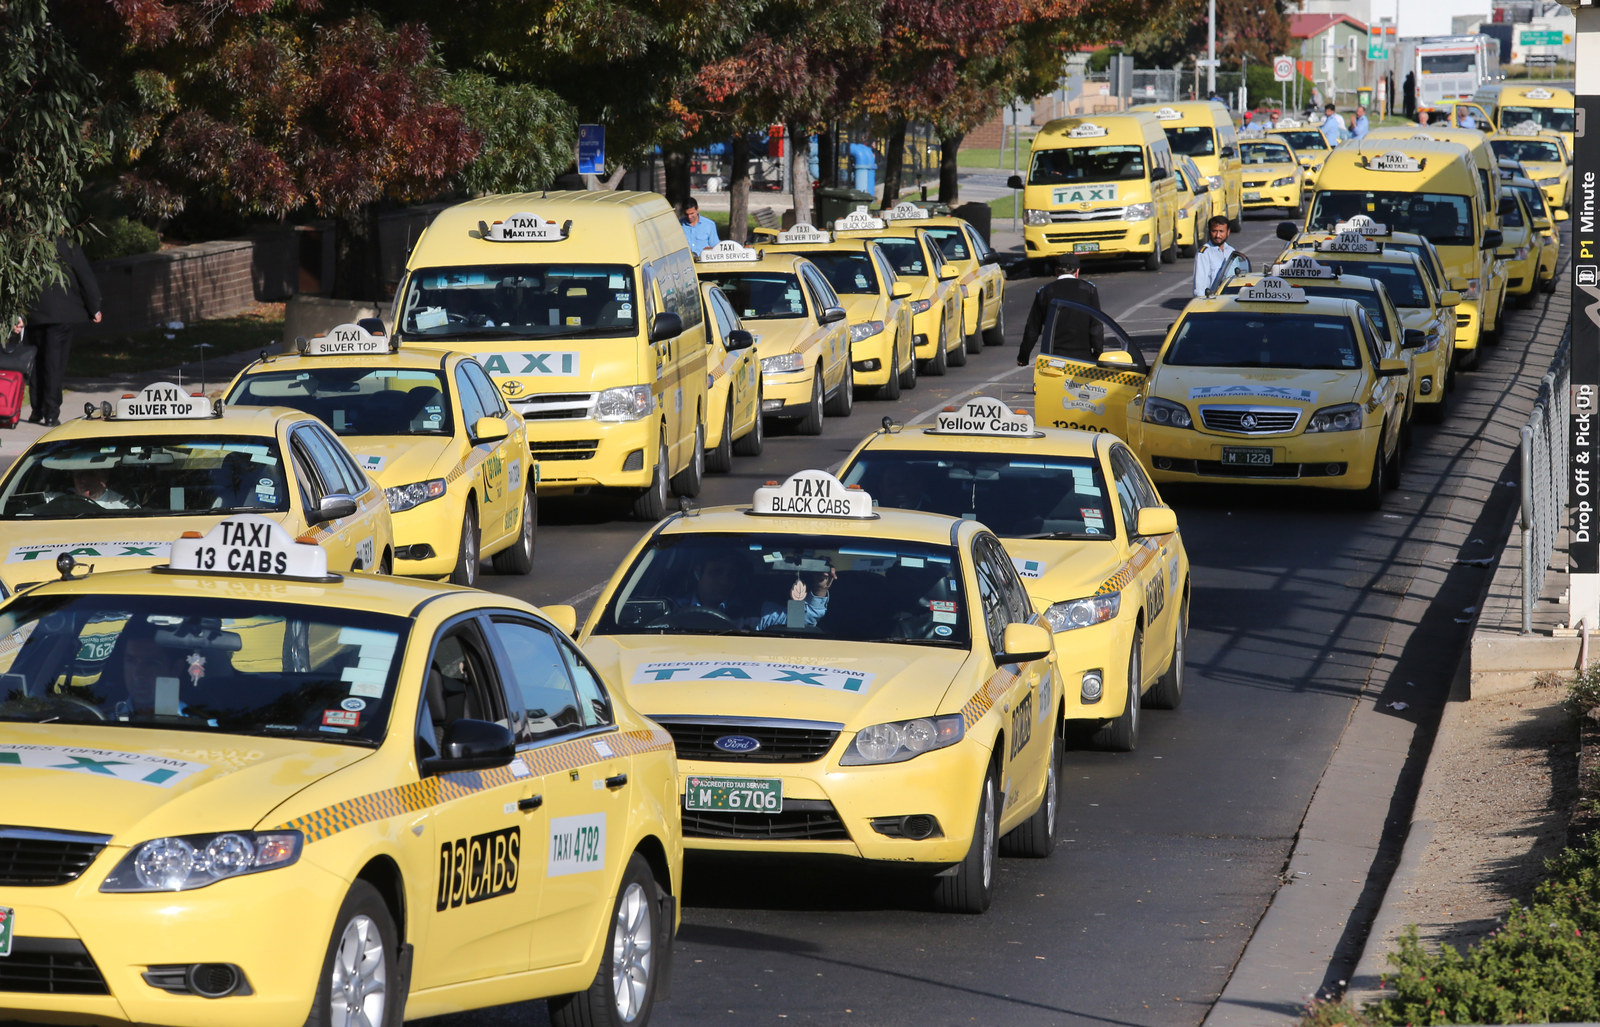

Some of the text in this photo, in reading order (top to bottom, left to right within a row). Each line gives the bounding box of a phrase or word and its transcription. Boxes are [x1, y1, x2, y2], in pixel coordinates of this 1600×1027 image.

[1278, 65, 1290, 73] 40
[1386, 154, 1402, 163] TAXI
[1054, 190, 1114, 203] TAXI
[1580, 172, 1595, 232] Minute
[512, 218, 538, 228] TAXI
[843, 222, 860, 230] BLACK
[1352, 218, 1370, 227] TAXI
[503, 228, 546, 239] MAXI TAXI
[1340, 234, 1360, 244] TAXI
[1330, 243, 1350, 251] BLACK
[1580, 240, 1594, 258] P1
[726, 252, 750, 260] SERVICE
[1292, 258, 1312, 268] TAXI
[1280, 268, 1305, 276] SILVER
[1264, 280, 1282, 288] TAXI
[335, 331, 360, 342] TAXI
[320, 342, 378, 352] SILVER TOP
[472, 353, 572, 374] AXI
[144, 389, 178, 402] TAXI
[1193, 386, 1312, 398] TAXI
[128, 403, 192, 416] SILVER TOP
[967, 404, 1002, 418] TAXI
[938, 418, 1028, 432] Yellow Cabs
[1228, 453, 1271, 464] M 1228
[1575, 384, 1594, 542] Drop Off & Pick Up
[793, 478, 830, 498] TAXI
[772, 497, 850, 515] BLACK CABS
[220, 521, 272, 548] TAXI
[15, 546, 160, 560] TAX
[195, 547, 288, 574] 13 CABS
[832, 668, 865, 678] 5AM
[644, 668, 864, 692] TAXI
[724, 738, 750, 750] Ford
[62, 746, 113, 756] 10PM
[116, 752, 140, 760] TO
[144, 756, 188, 768] 5AM
[0, 752, 180, 785] XI
[746, 782, 770, 790] SERVICE
[688, 788, 696, 806] VIC
[700, 788, 776, 808] M 6706
[553, 826, 600, 863] TAXI 4792
[438, 829, 520, 905] 13CABS
